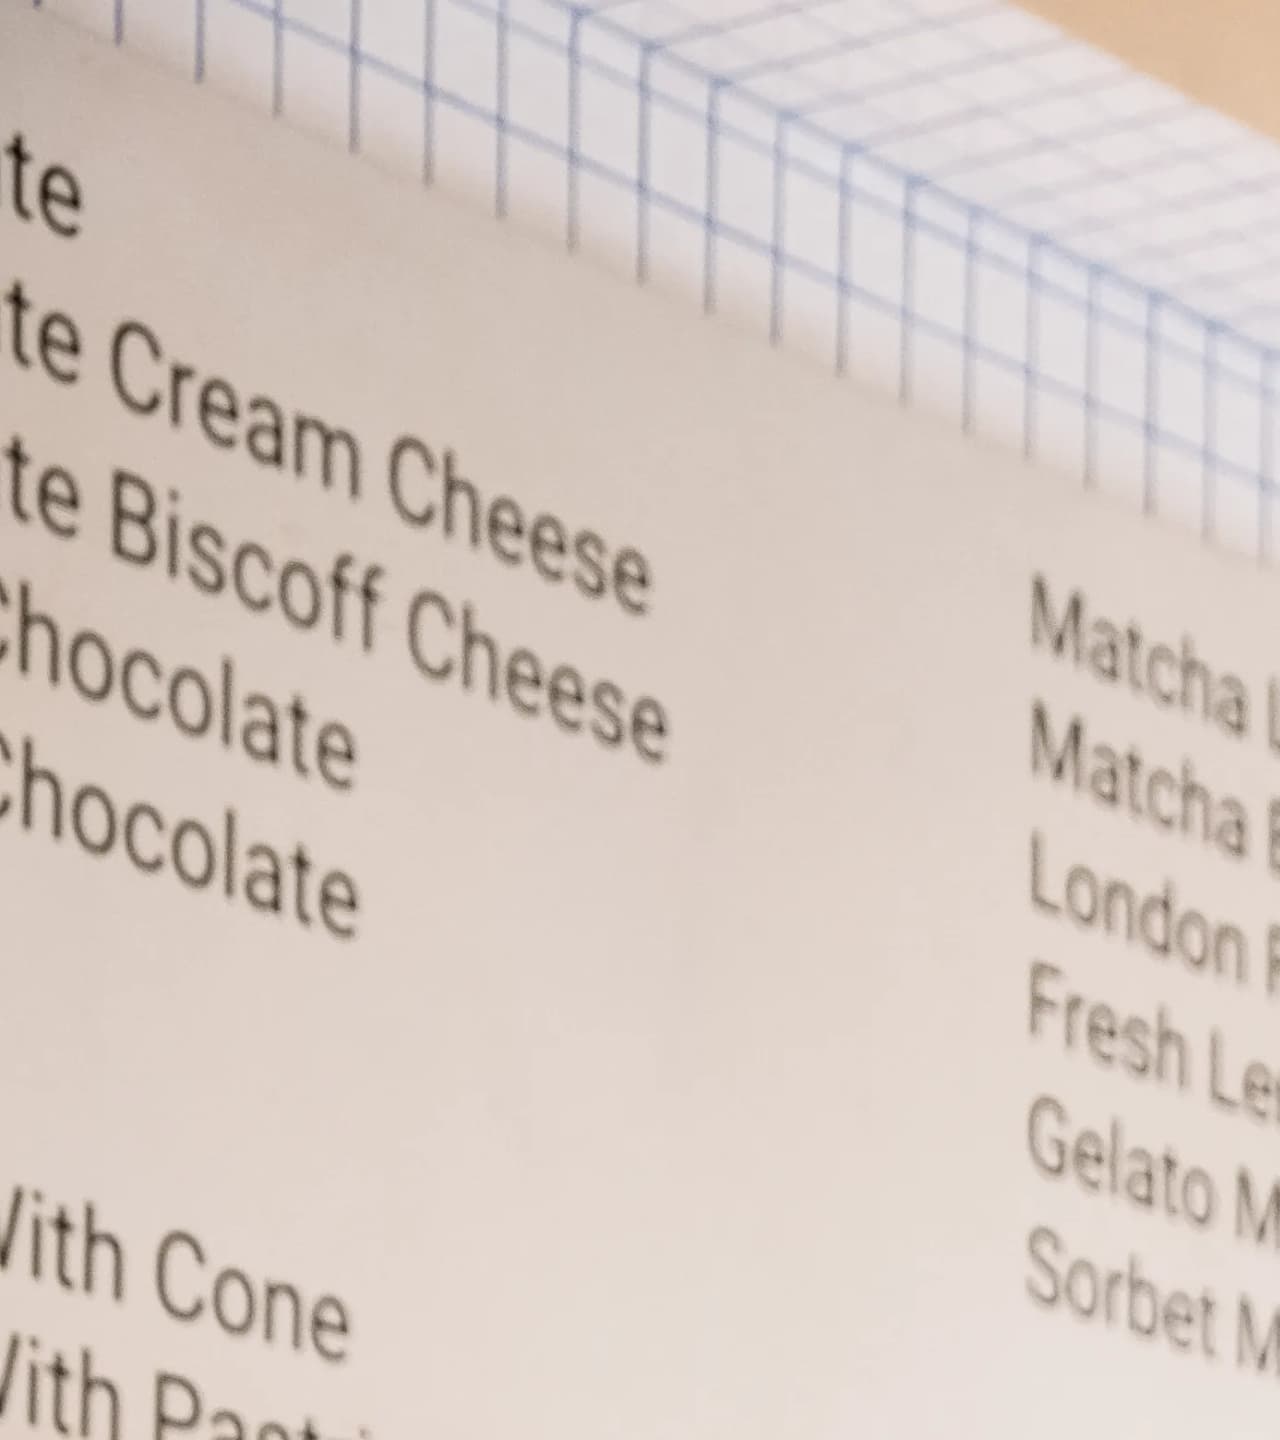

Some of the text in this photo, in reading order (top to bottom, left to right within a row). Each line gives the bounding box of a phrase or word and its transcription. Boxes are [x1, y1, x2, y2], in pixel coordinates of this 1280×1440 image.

[110, 320, 361, 501] Cream
[389, 435, 651, 616] Cheese
[111, 468, 385, 653] Biscoff
[408, 590, 669, 765] Cheese
[1032, 573, 1248, 738] Matcha
[1032, 700, 1248, 860] Matcha
[1031, 832, 1246, 982] London
[1030, 961, 1188, 1088] Fresh
[1028, 1096, 1215, 1228] Gelato
[156, 1230, 350, 1364] Cone
[1028, 1227, 1215, 1357] Sorbet
